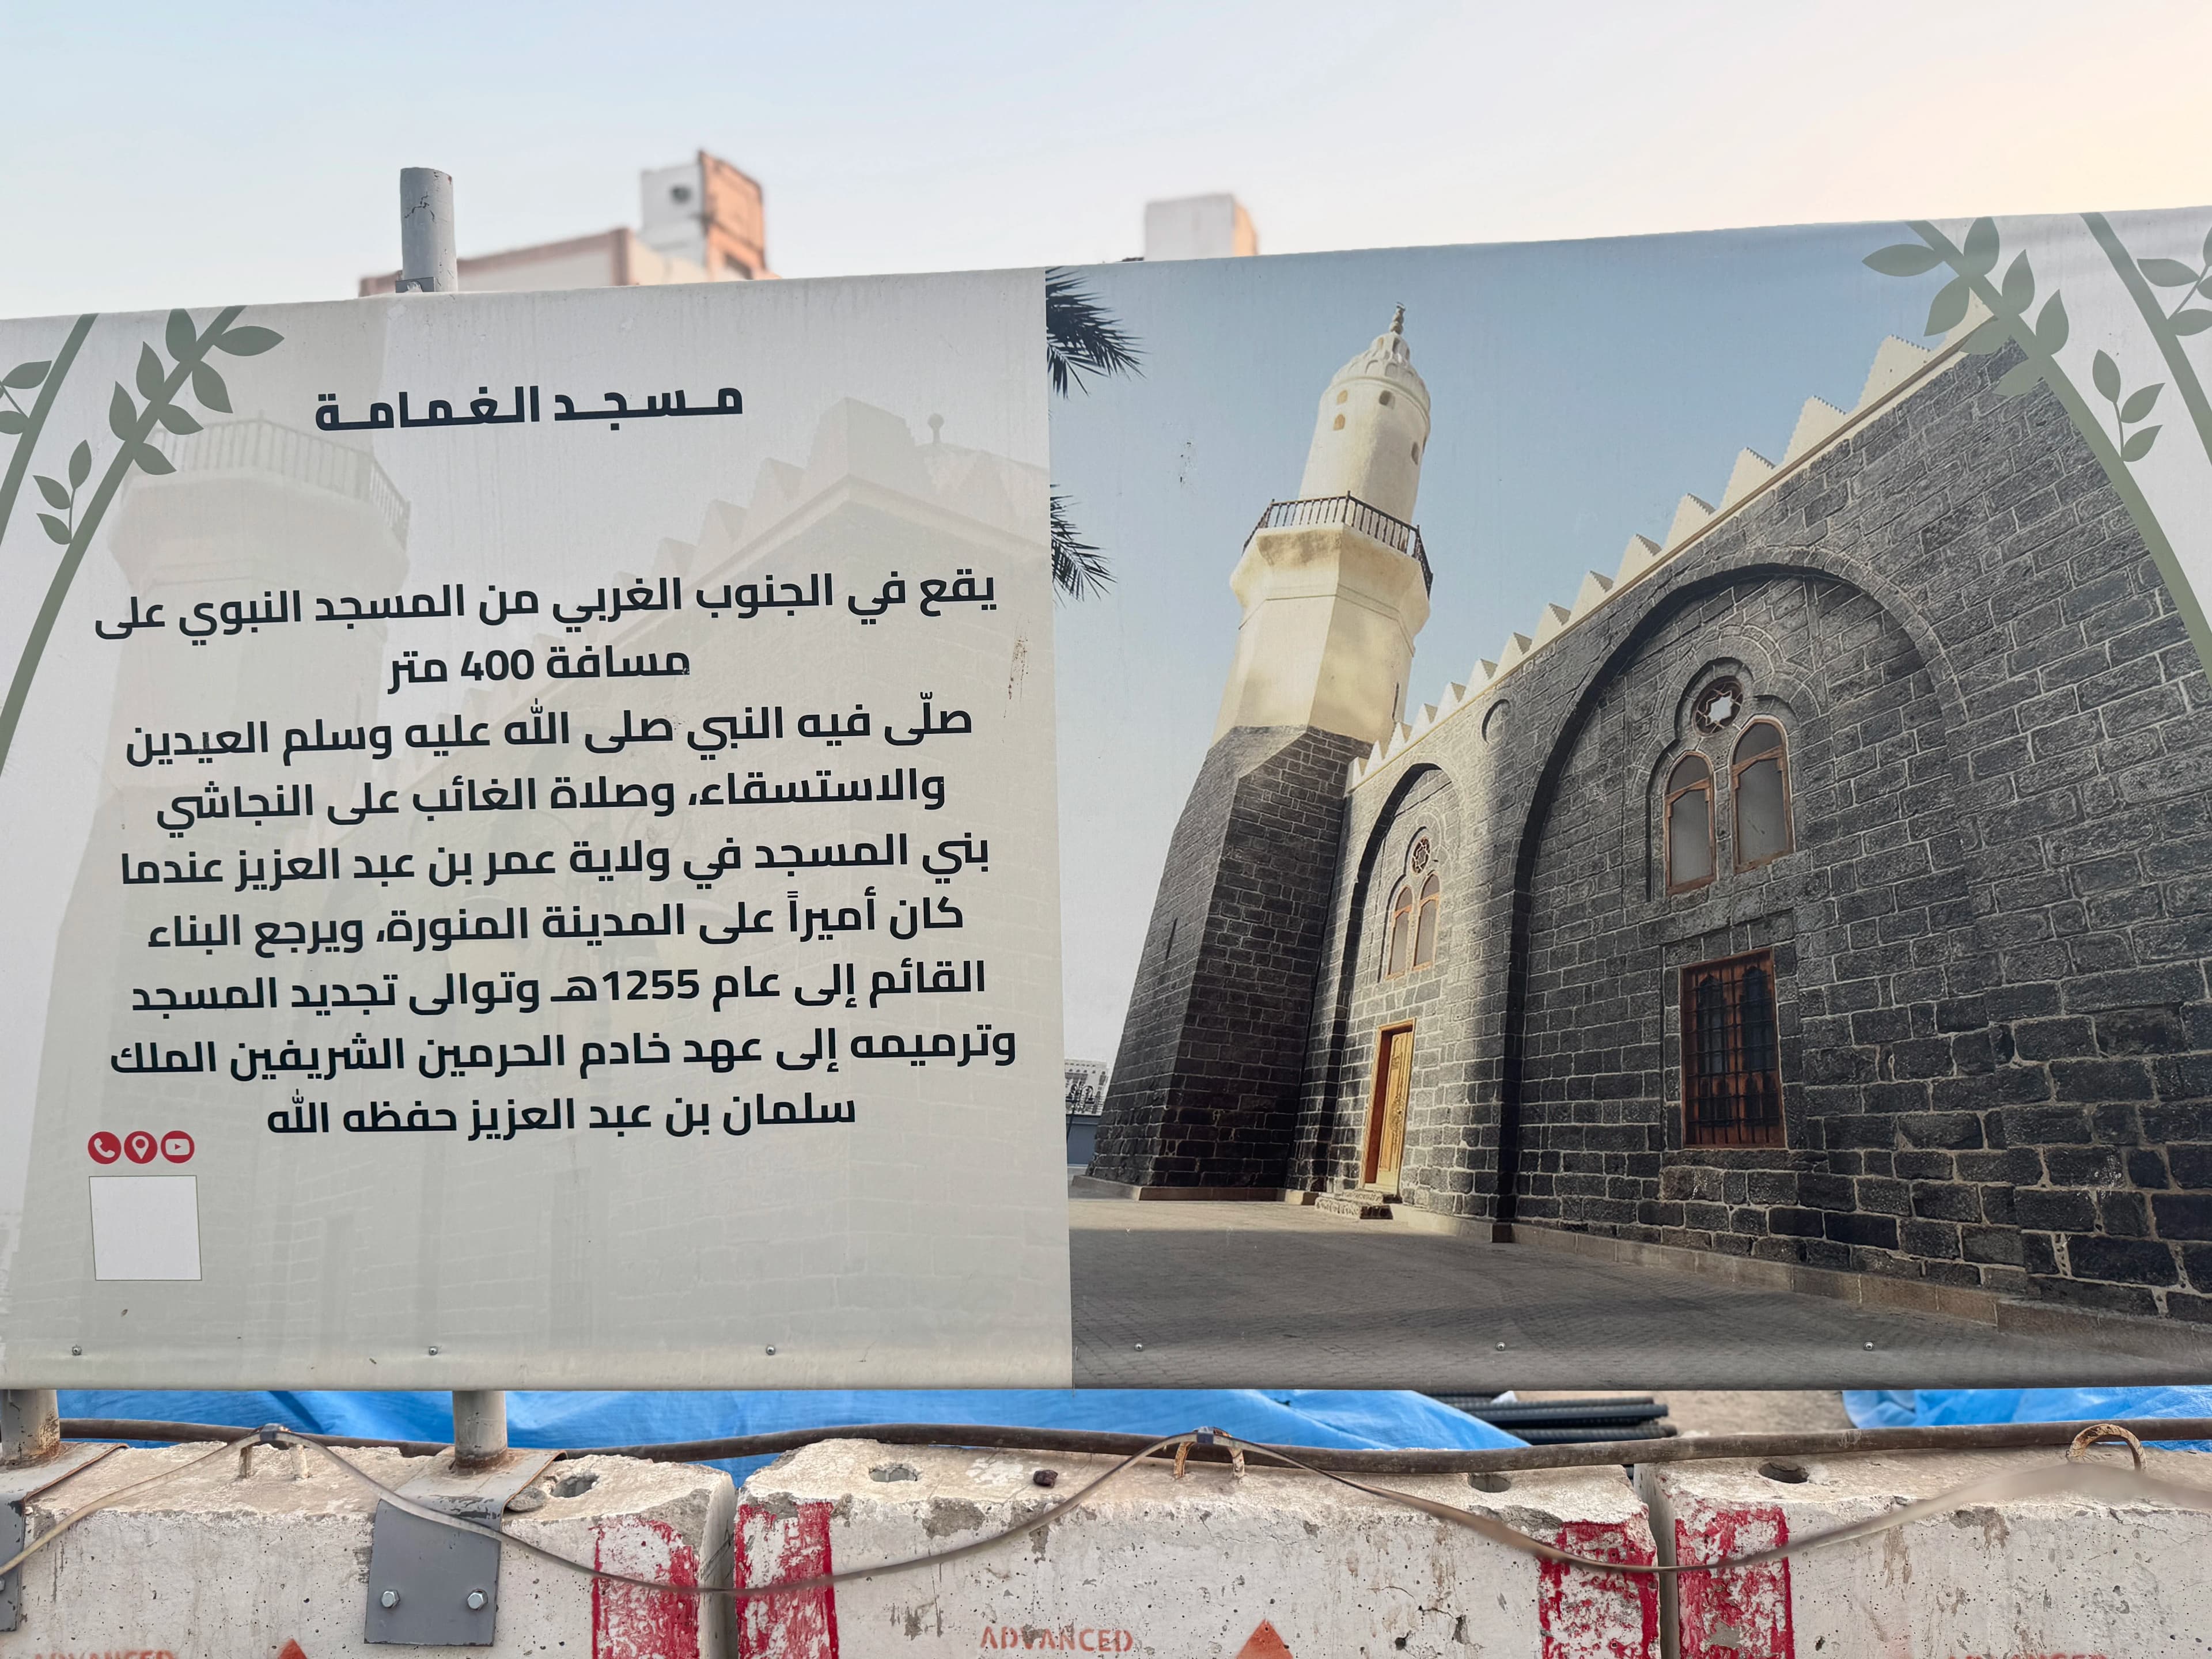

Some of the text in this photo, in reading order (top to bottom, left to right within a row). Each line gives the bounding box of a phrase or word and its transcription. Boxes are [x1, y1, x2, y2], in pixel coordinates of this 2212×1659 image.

[315, 385, 743, 431] مسجد الغمامة
[95, 569, 997, 646] يقع في الجنوب الغربي من المسجد النبوي على
[387, 645, 690, 695] مسافة 400 متر
[126, 721, 268, 767] العيدين
[283, 718, 392, 767] وسلم
[405, 714, 490, 757] عليه
[504, 698, 569, 745] الله
[585, 710, 673, 754] صلى
[687, 706, 783, 761] النبي
[797, 704, 870, 747] فيه
[157, 781, 313, 838] النجاشي
[327, 782, 399, 825] على
[412, 775, 536, 821] الغائب
[550, 775, 675, 817] وصلاة
[122, 832, 988, 892] بني المسجد في ولاية عمر بن عبد العزيز عندما
[148, 914, 241, 955] البناء
[255, 920, 363, 959] ويرجع
[543, 903, 684, 946] المدينة
[699, 902, 774, 945] على
[889, 896, 963, 940] كان
[132, 976, 277, 1020] المسجد
[291, 974, 398, 1016] تجديد
[409, 971, 539, 1016] وتوالى
[713, 965, 780, 1012] عام
[794, 963, 857, 1008] إلى
[869, 957, 985, 1009] القائم
[111, 1024, 1016, 1082] وترميمه إلى عهد خادم الحرمين الشريفين الملك
[267, 1088, 855, 1141] سلمان بن عبد العزيز حفظه الله
